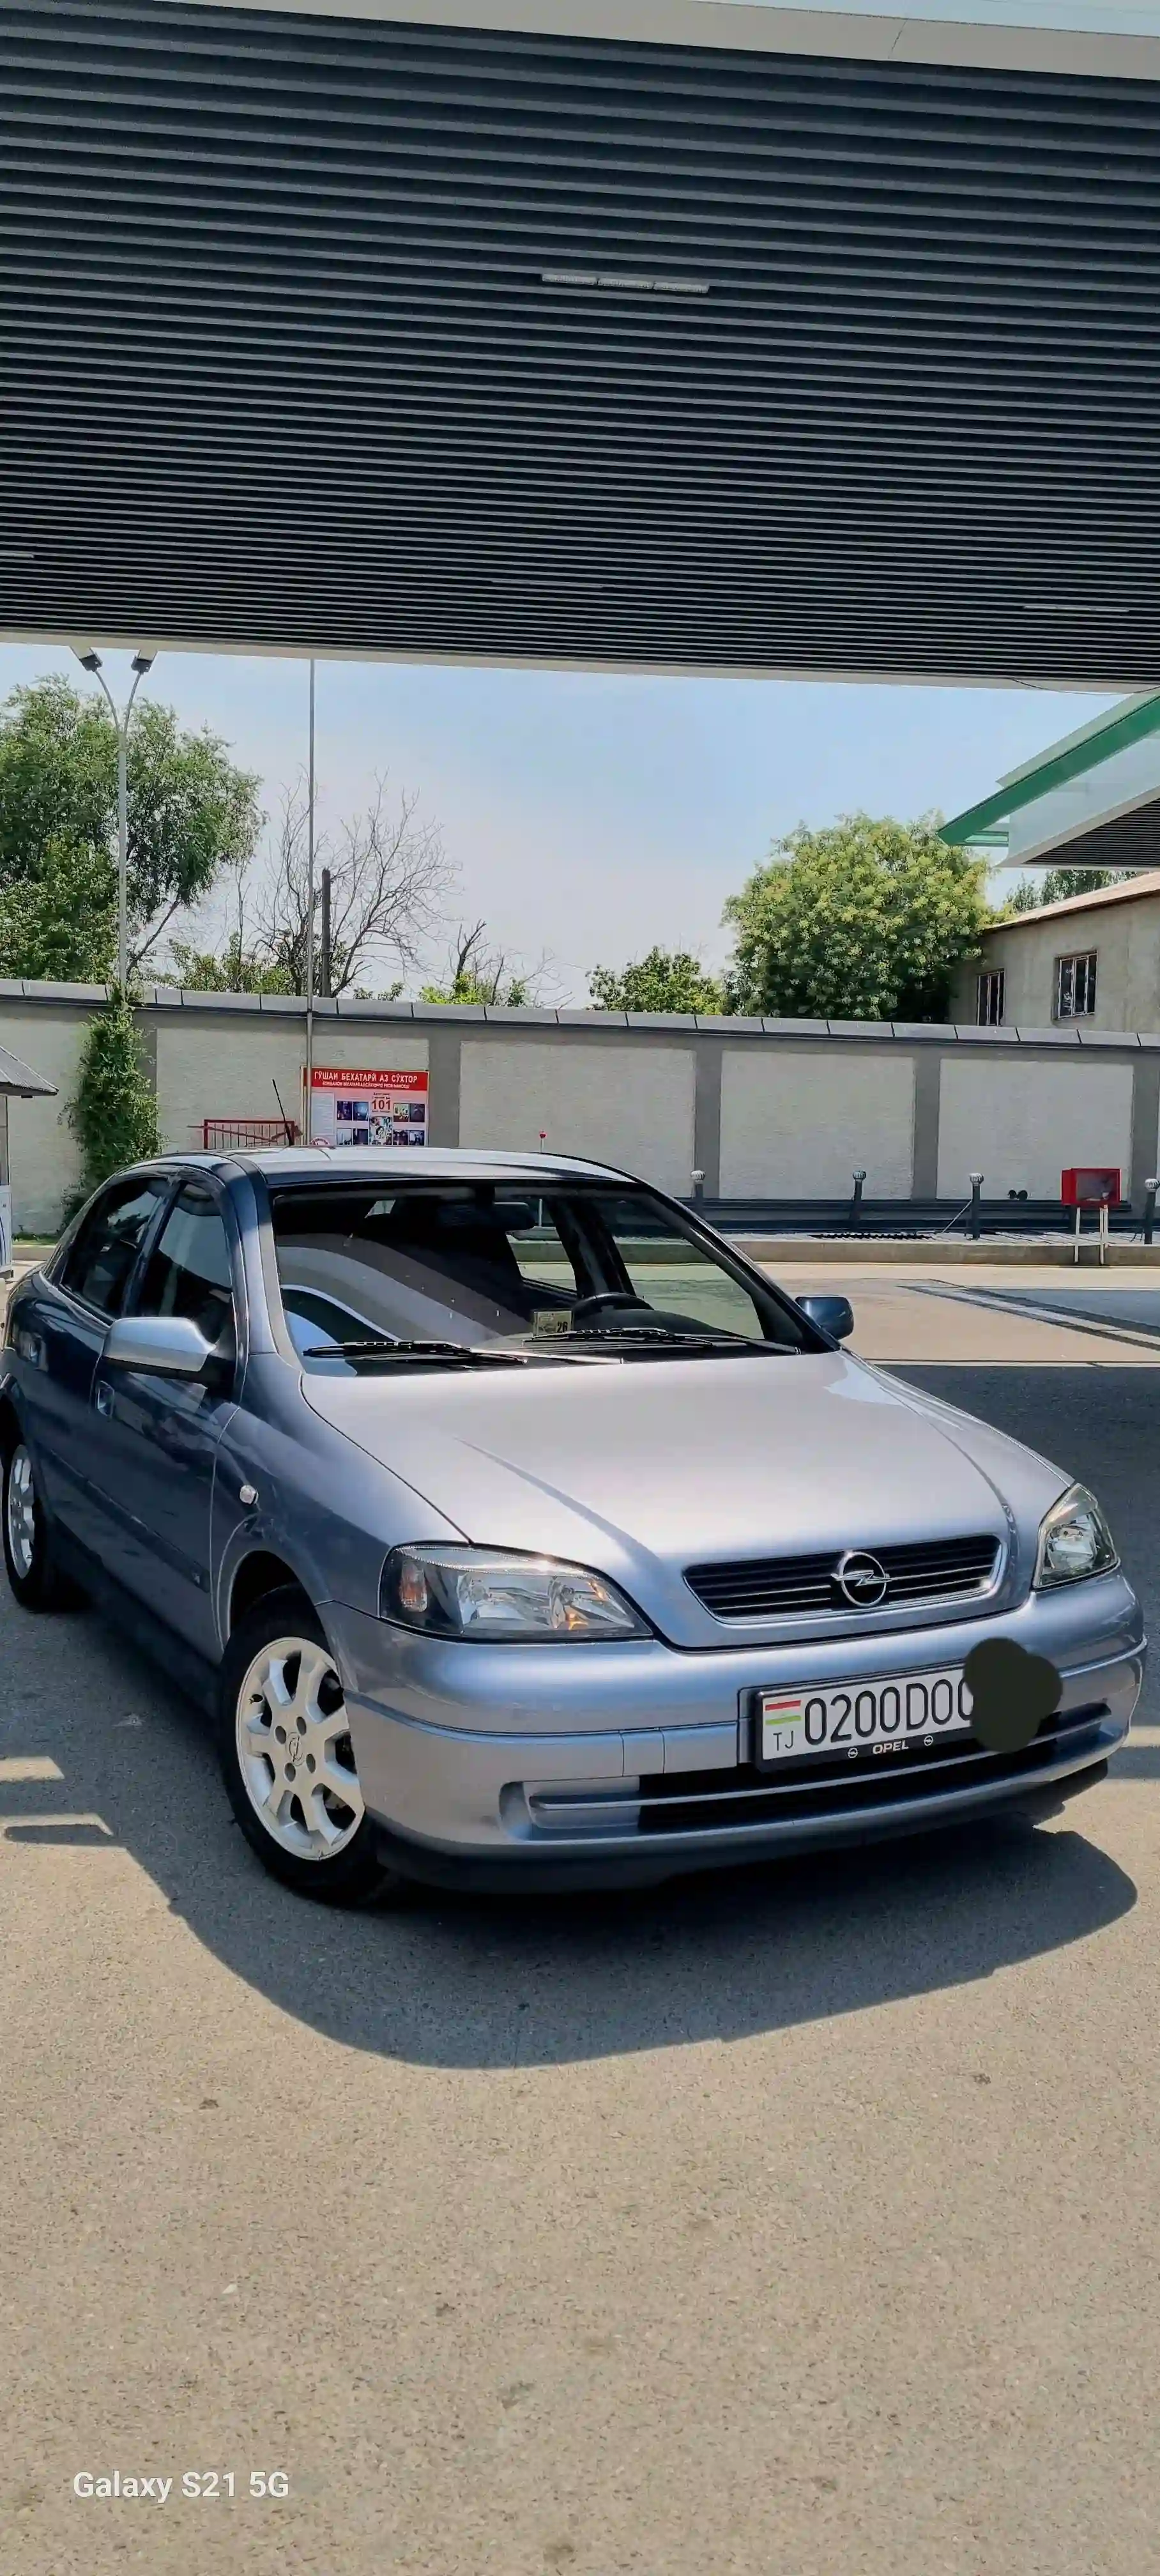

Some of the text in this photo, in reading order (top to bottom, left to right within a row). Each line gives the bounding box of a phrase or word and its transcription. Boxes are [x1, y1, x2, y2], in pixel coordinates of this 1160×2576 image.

[379, 1074, 388, 1082] АЗ
[372, 1099, 390, 1110] 101
[773, 1730, 794, 1751] TJ
[873, 1740, 909, 1755] OPEL
